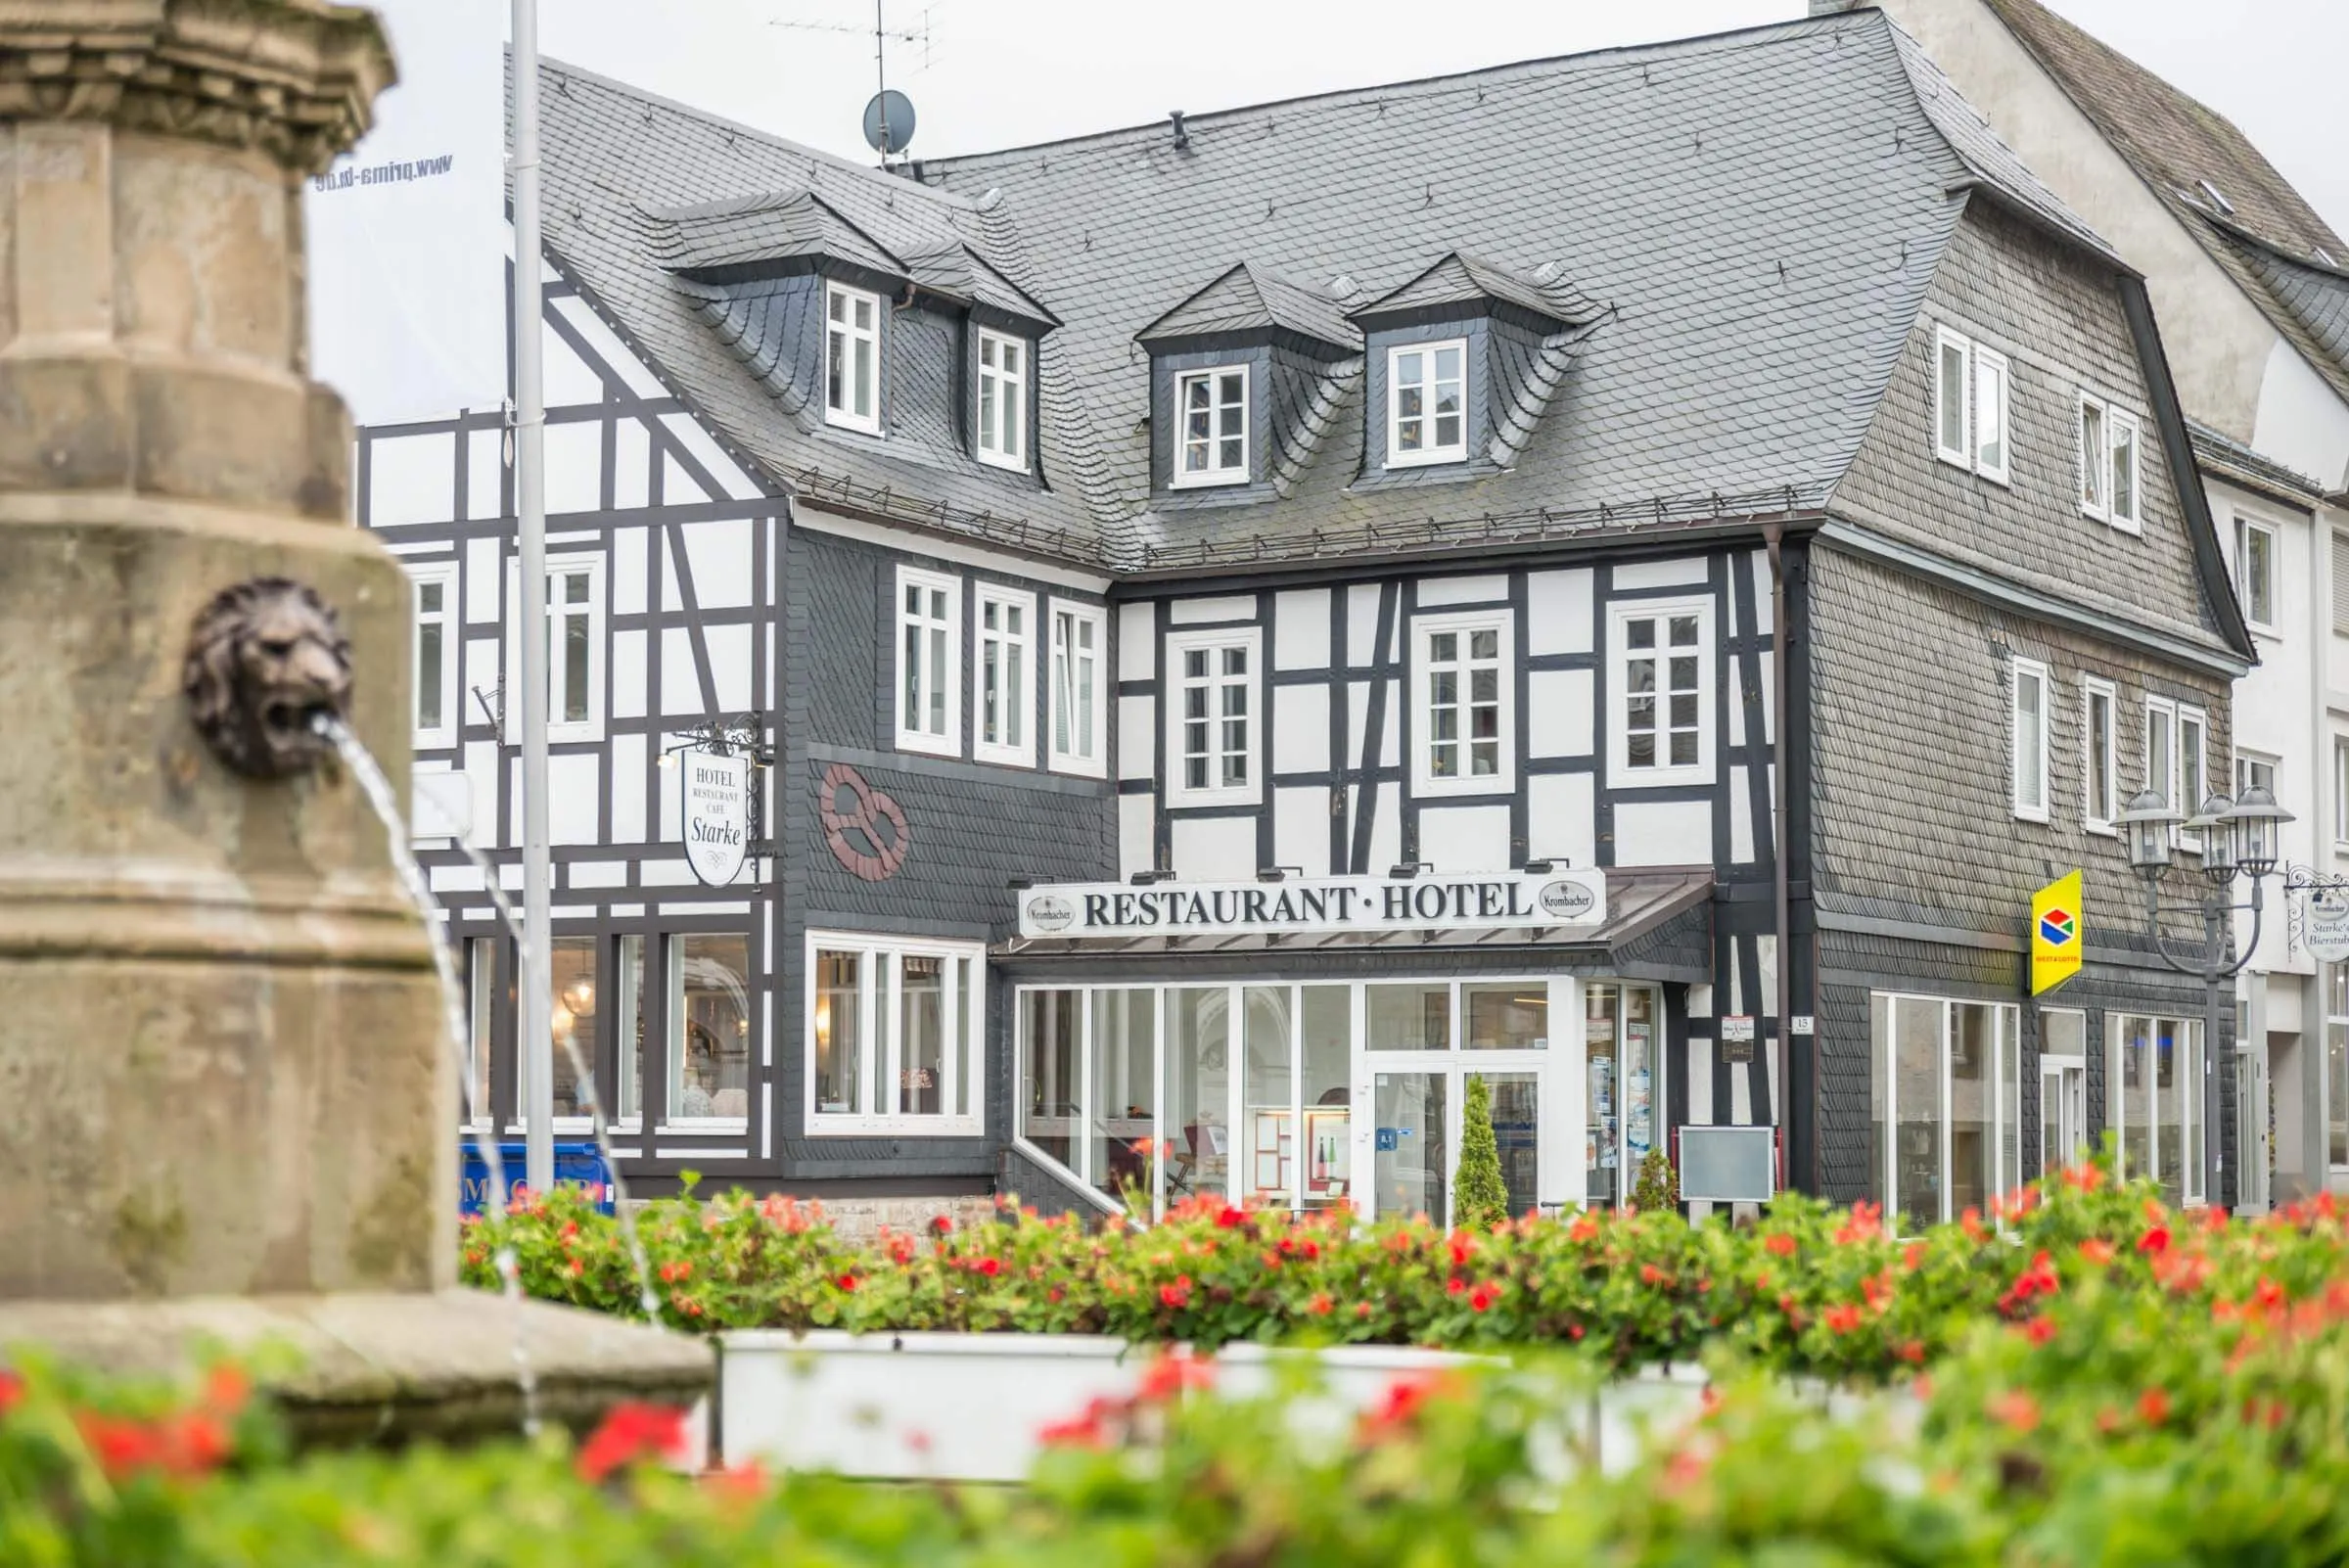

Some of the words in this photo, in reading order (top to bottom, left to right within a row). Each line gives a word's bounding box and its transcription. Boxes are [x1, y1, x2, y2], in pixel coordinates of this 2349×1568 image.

[696, 766, 736, 787] HOTEL
[692, 787, 739, 802] RESTAURANT
[691, 816, 741, 845] Starke
[1083, 887, 1357, 926] RESTAURANT
[1381, 882, 1534, 920] HOTEL
[1543, 894, 1590, 907] Krombacher
[1031, 908, 1071, 921] Krombacher
